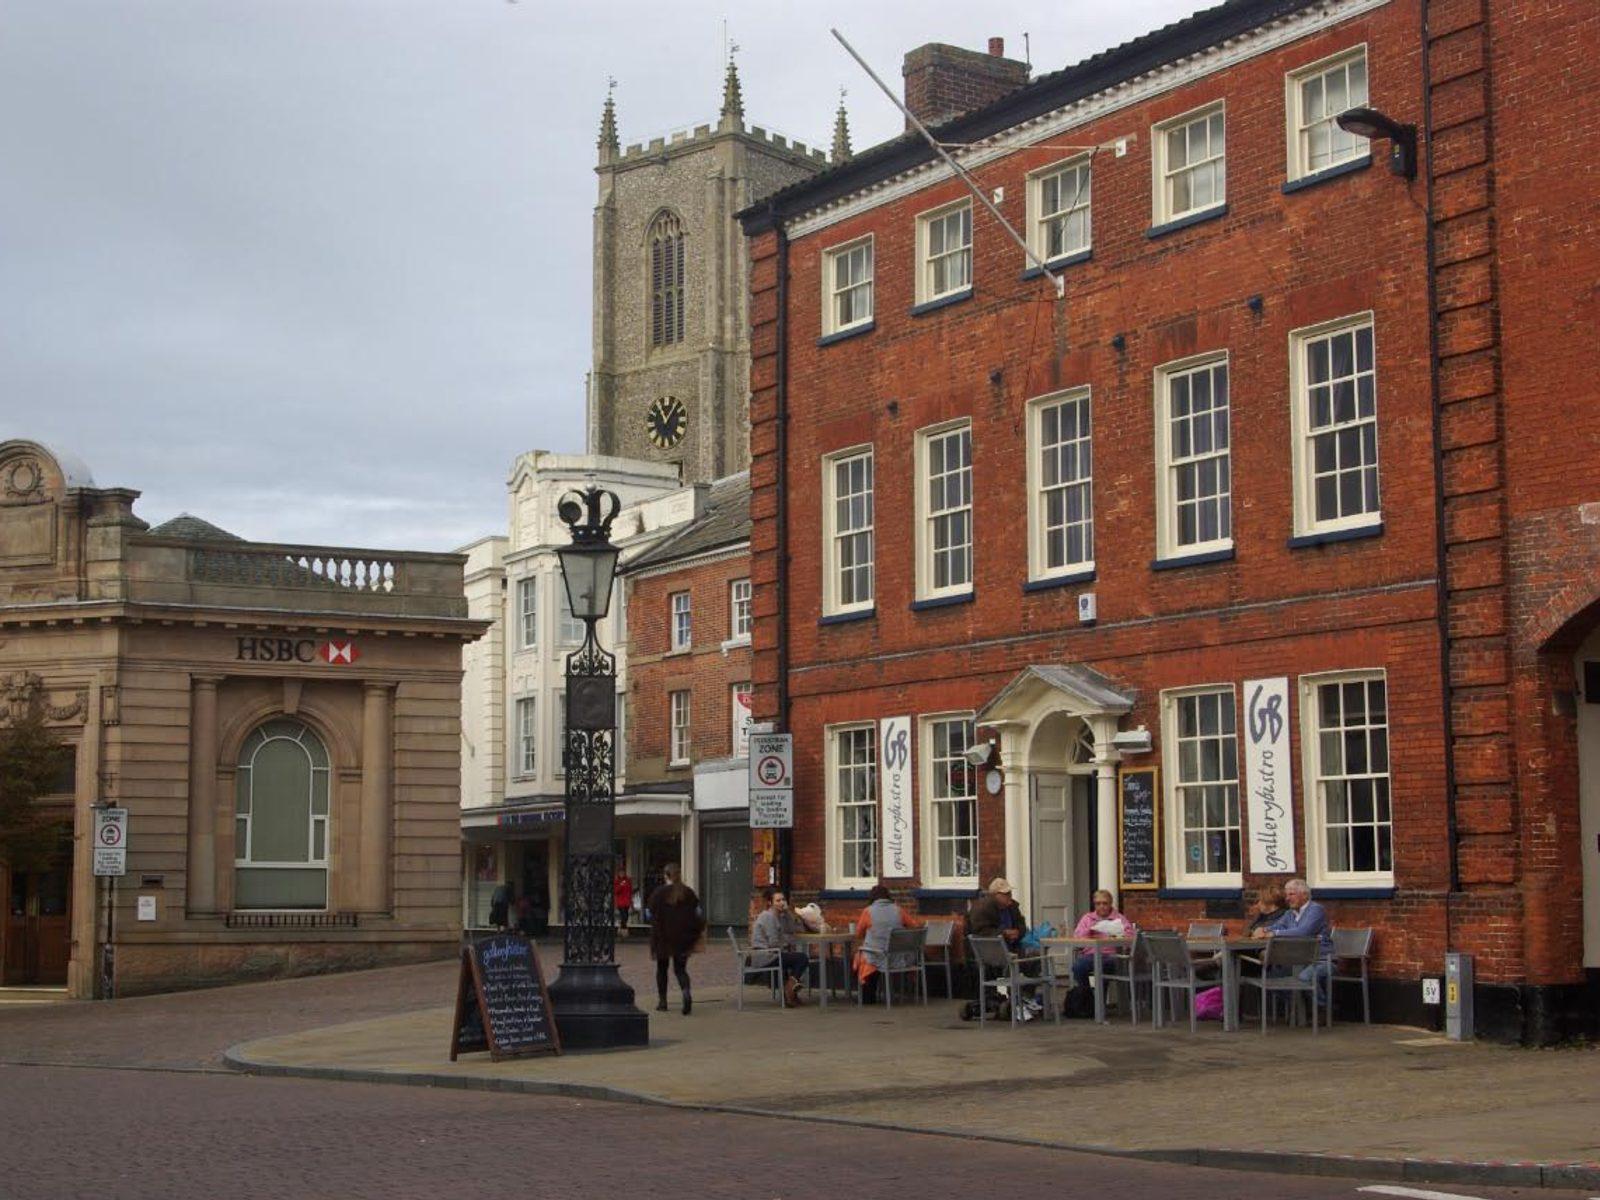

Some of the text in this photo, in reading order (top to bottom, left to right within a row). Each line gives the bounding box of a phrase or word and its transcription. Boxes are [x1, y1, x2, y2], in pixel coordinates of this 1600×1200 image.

[236, 637, 316, 662] HSBC
[759, 744, 784, 753] ZONE
[887, 773, 908, 873] gallerybistro
[1255, 750, 1288, 871] gallerybistro
